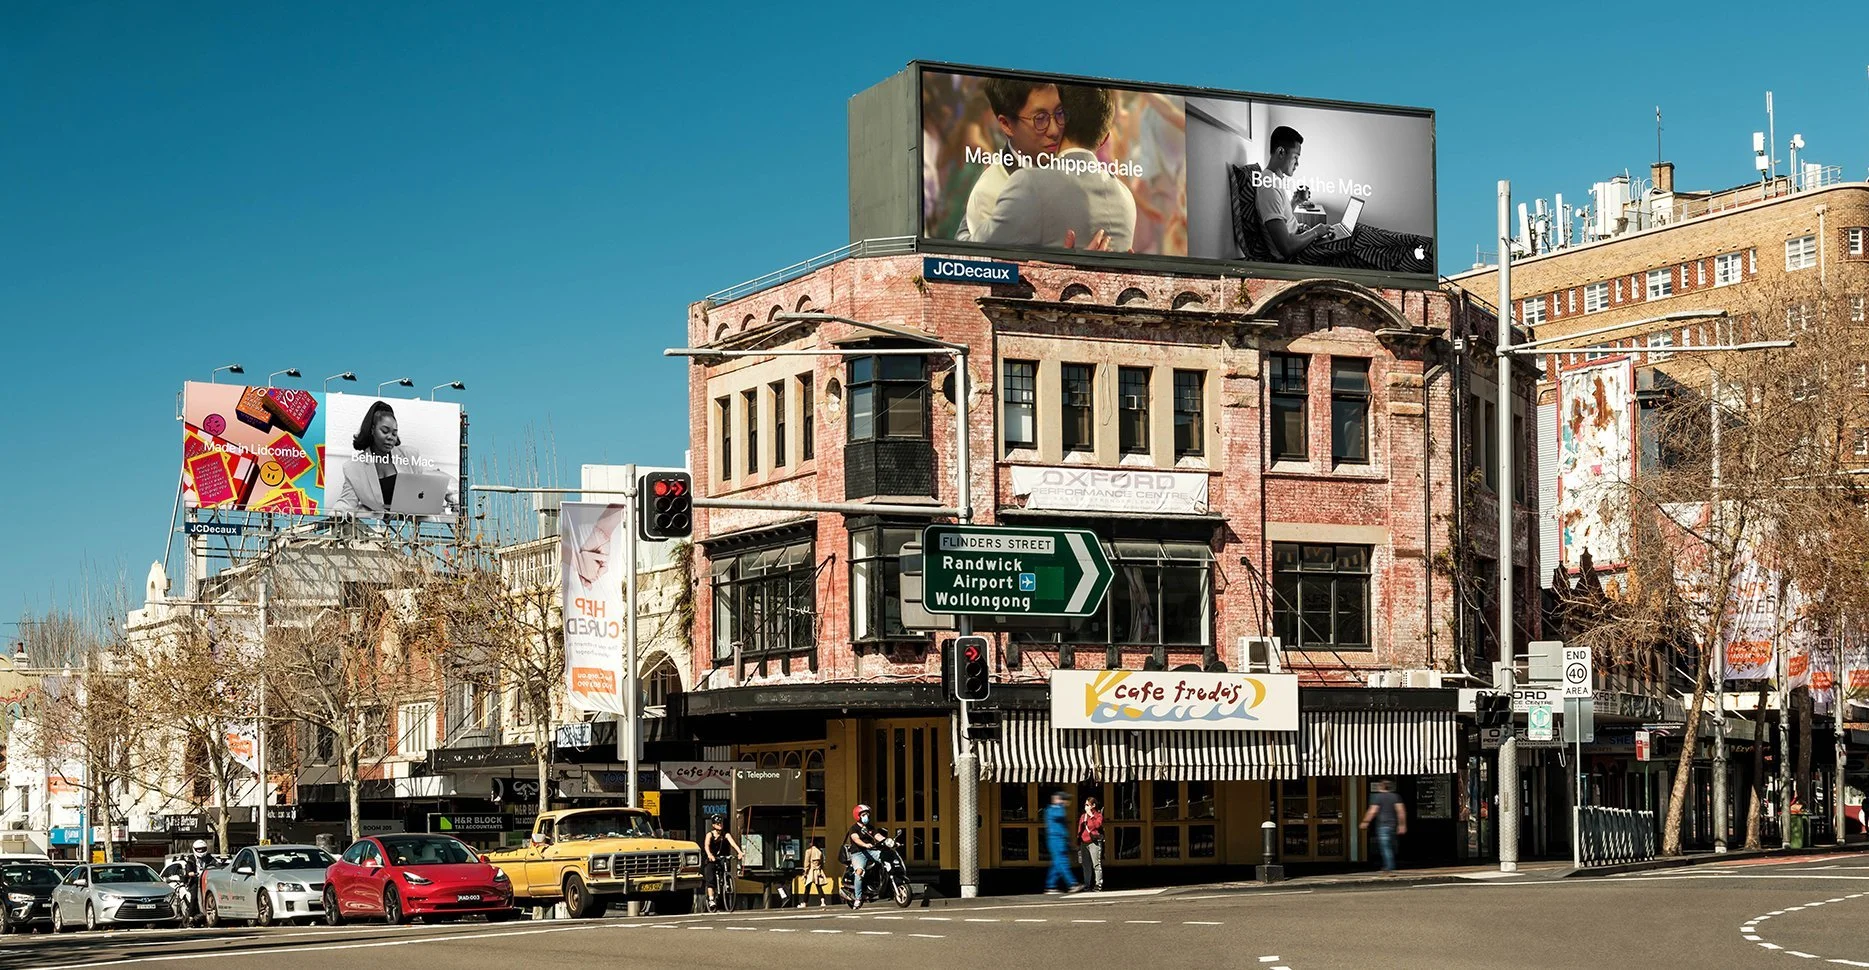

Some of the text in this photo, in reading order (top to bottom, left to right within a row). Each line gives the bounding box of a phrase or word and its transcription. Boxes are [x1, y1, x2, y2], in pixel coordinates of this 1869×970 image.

[965, 146, 1143, 177] Made in Chippendale
[1252, 170, 1372, 196] Behind the Mac
[933, 261, 1010, 280] JCDecaux
[204, 441, 236, 453] Made
[239, 443, 248, 454] in
[251, 444, 307, 458] Lidcombe
[352, 451, 435, 467] Behind the Mac
[1041, 470, 1176, 490] OXFORD
[1032, 488, 1191, 501] PERFORMANCE CENTRE
[191, 525, 237, 534] JCDecaux
[943, 536, 1052, 550] FLINDERS STREET
[943, 556, 1022, 572] Randwick
[953, 574, 1013, 591] Airport
[936, 592, 1030, 612] Wollongong
[1566, 650, 1587, 660] END
[1568, 668, 1585, 679] 40
[1115, 680, 1242, 704] cafe freda's
[1565, 687, 1589, 695] AREA
[676, 767, 703, 778] cafe
[746, 770, 780, 780] Telephone
[454, 816, 502, 824] H&R BLOCK
